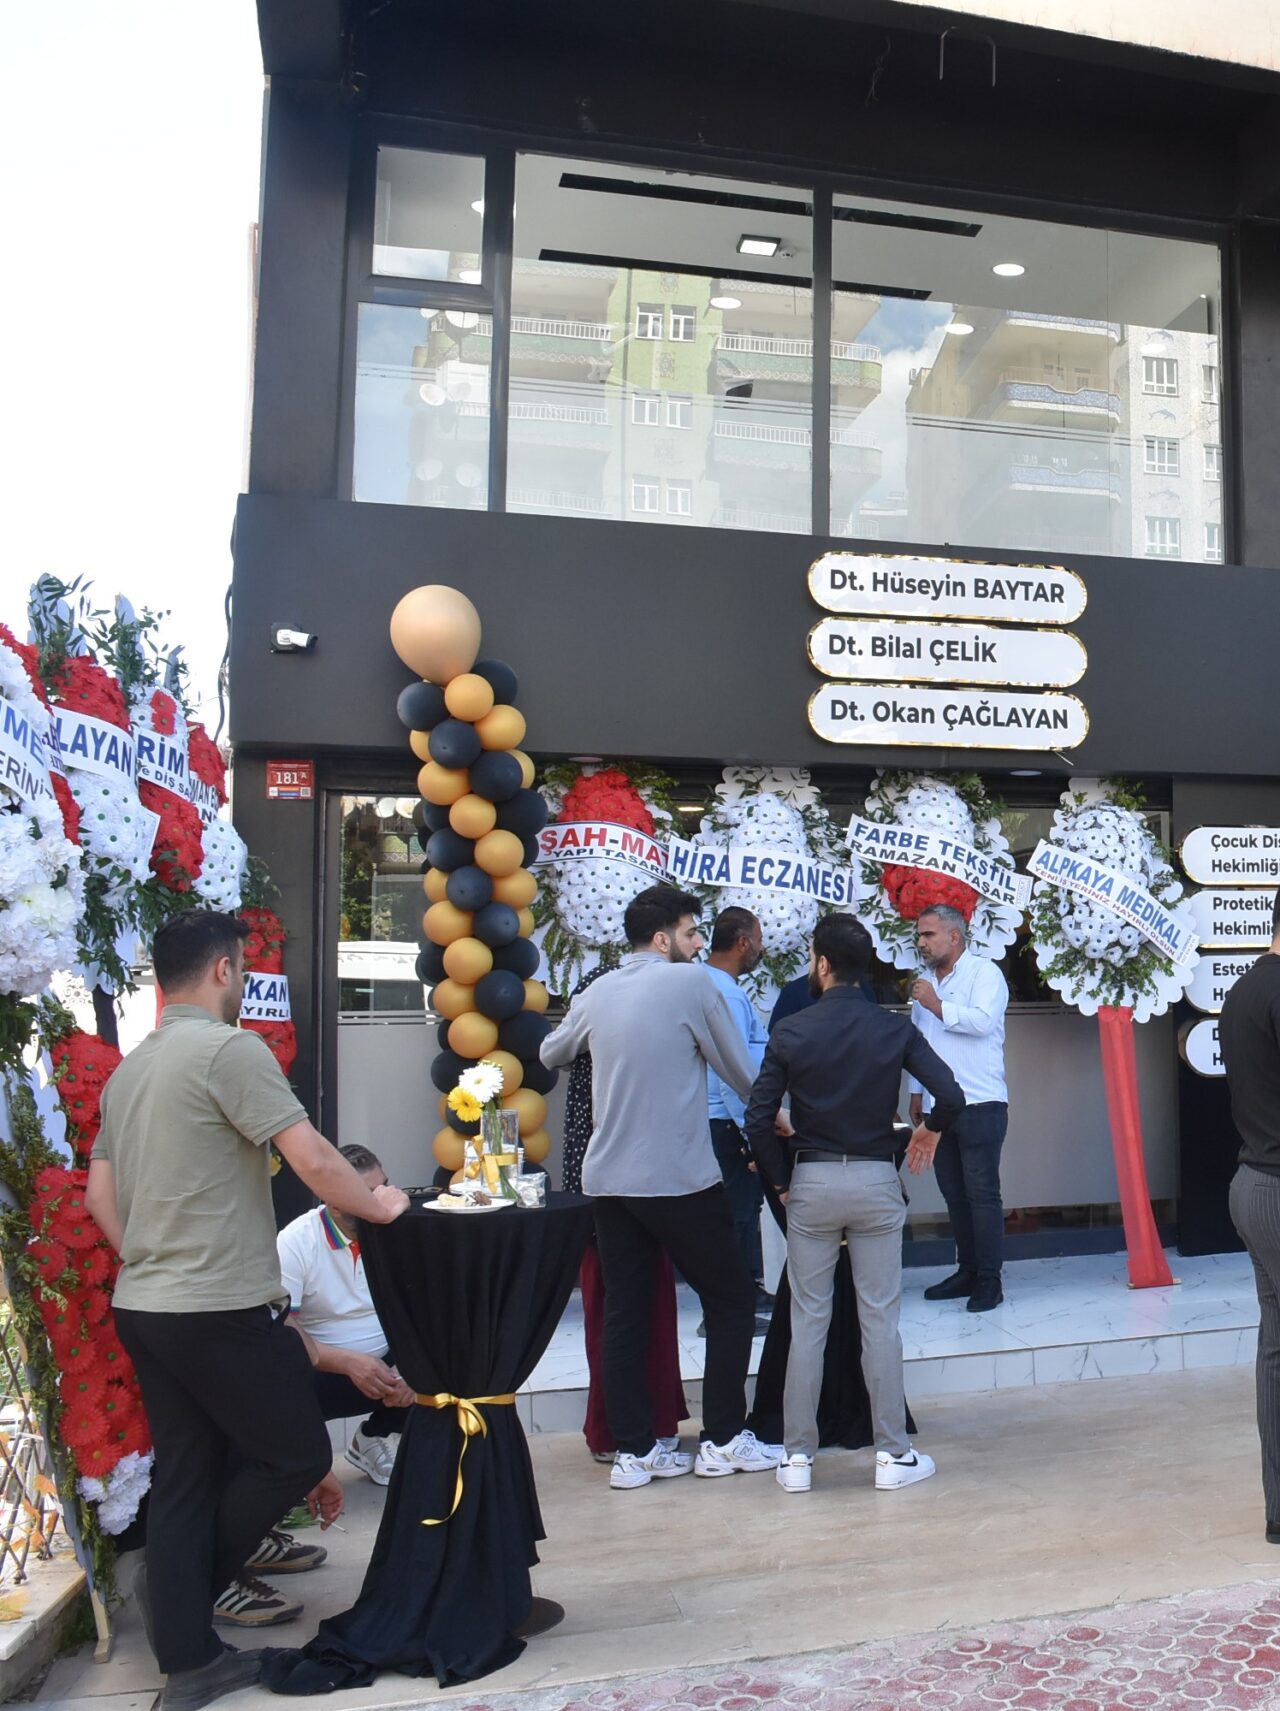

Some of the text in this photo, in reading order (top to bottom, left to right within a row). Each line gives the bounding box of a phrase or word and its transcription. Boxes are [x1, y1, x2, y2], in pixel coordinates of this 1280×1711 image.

[830, 569, 1065, 603] Dt. Hüseyin BAYTAR
[828, 634, 998, 666] Dt. Bilal ÇELİK
[830, 699, 1069, 731] Dt. Okan ÇAĞLAYAN
[276, 771, 299, 785] 181
[553, 848, 595, 858] YAPI
[854, 822, 930, 851] FARBE
[938, 840, 1017, 893] TEKSTİL
[1210, 834, 1258, 852] Çocuk
[673, 845, 731, 883] HİRA
[850, 840, 957, 873] RAMAZAN
[963, 868, 1015, 905] YAŞAR
[1034, 866, 1058, 883] YENİ
[1112, 904, 1148, 932] HAYIRLI
[1150, 931, 1176, 957] OLSUN
[1036, 850, 1115, 897] ALPKAYA
[1116, 885, 1182, 949] MEDİKAL
[1212, 896, 1274, 911] Protetik
[243, 976, 287, 1003] KAN
[241, 1006, 289, 1018] YIRLI
